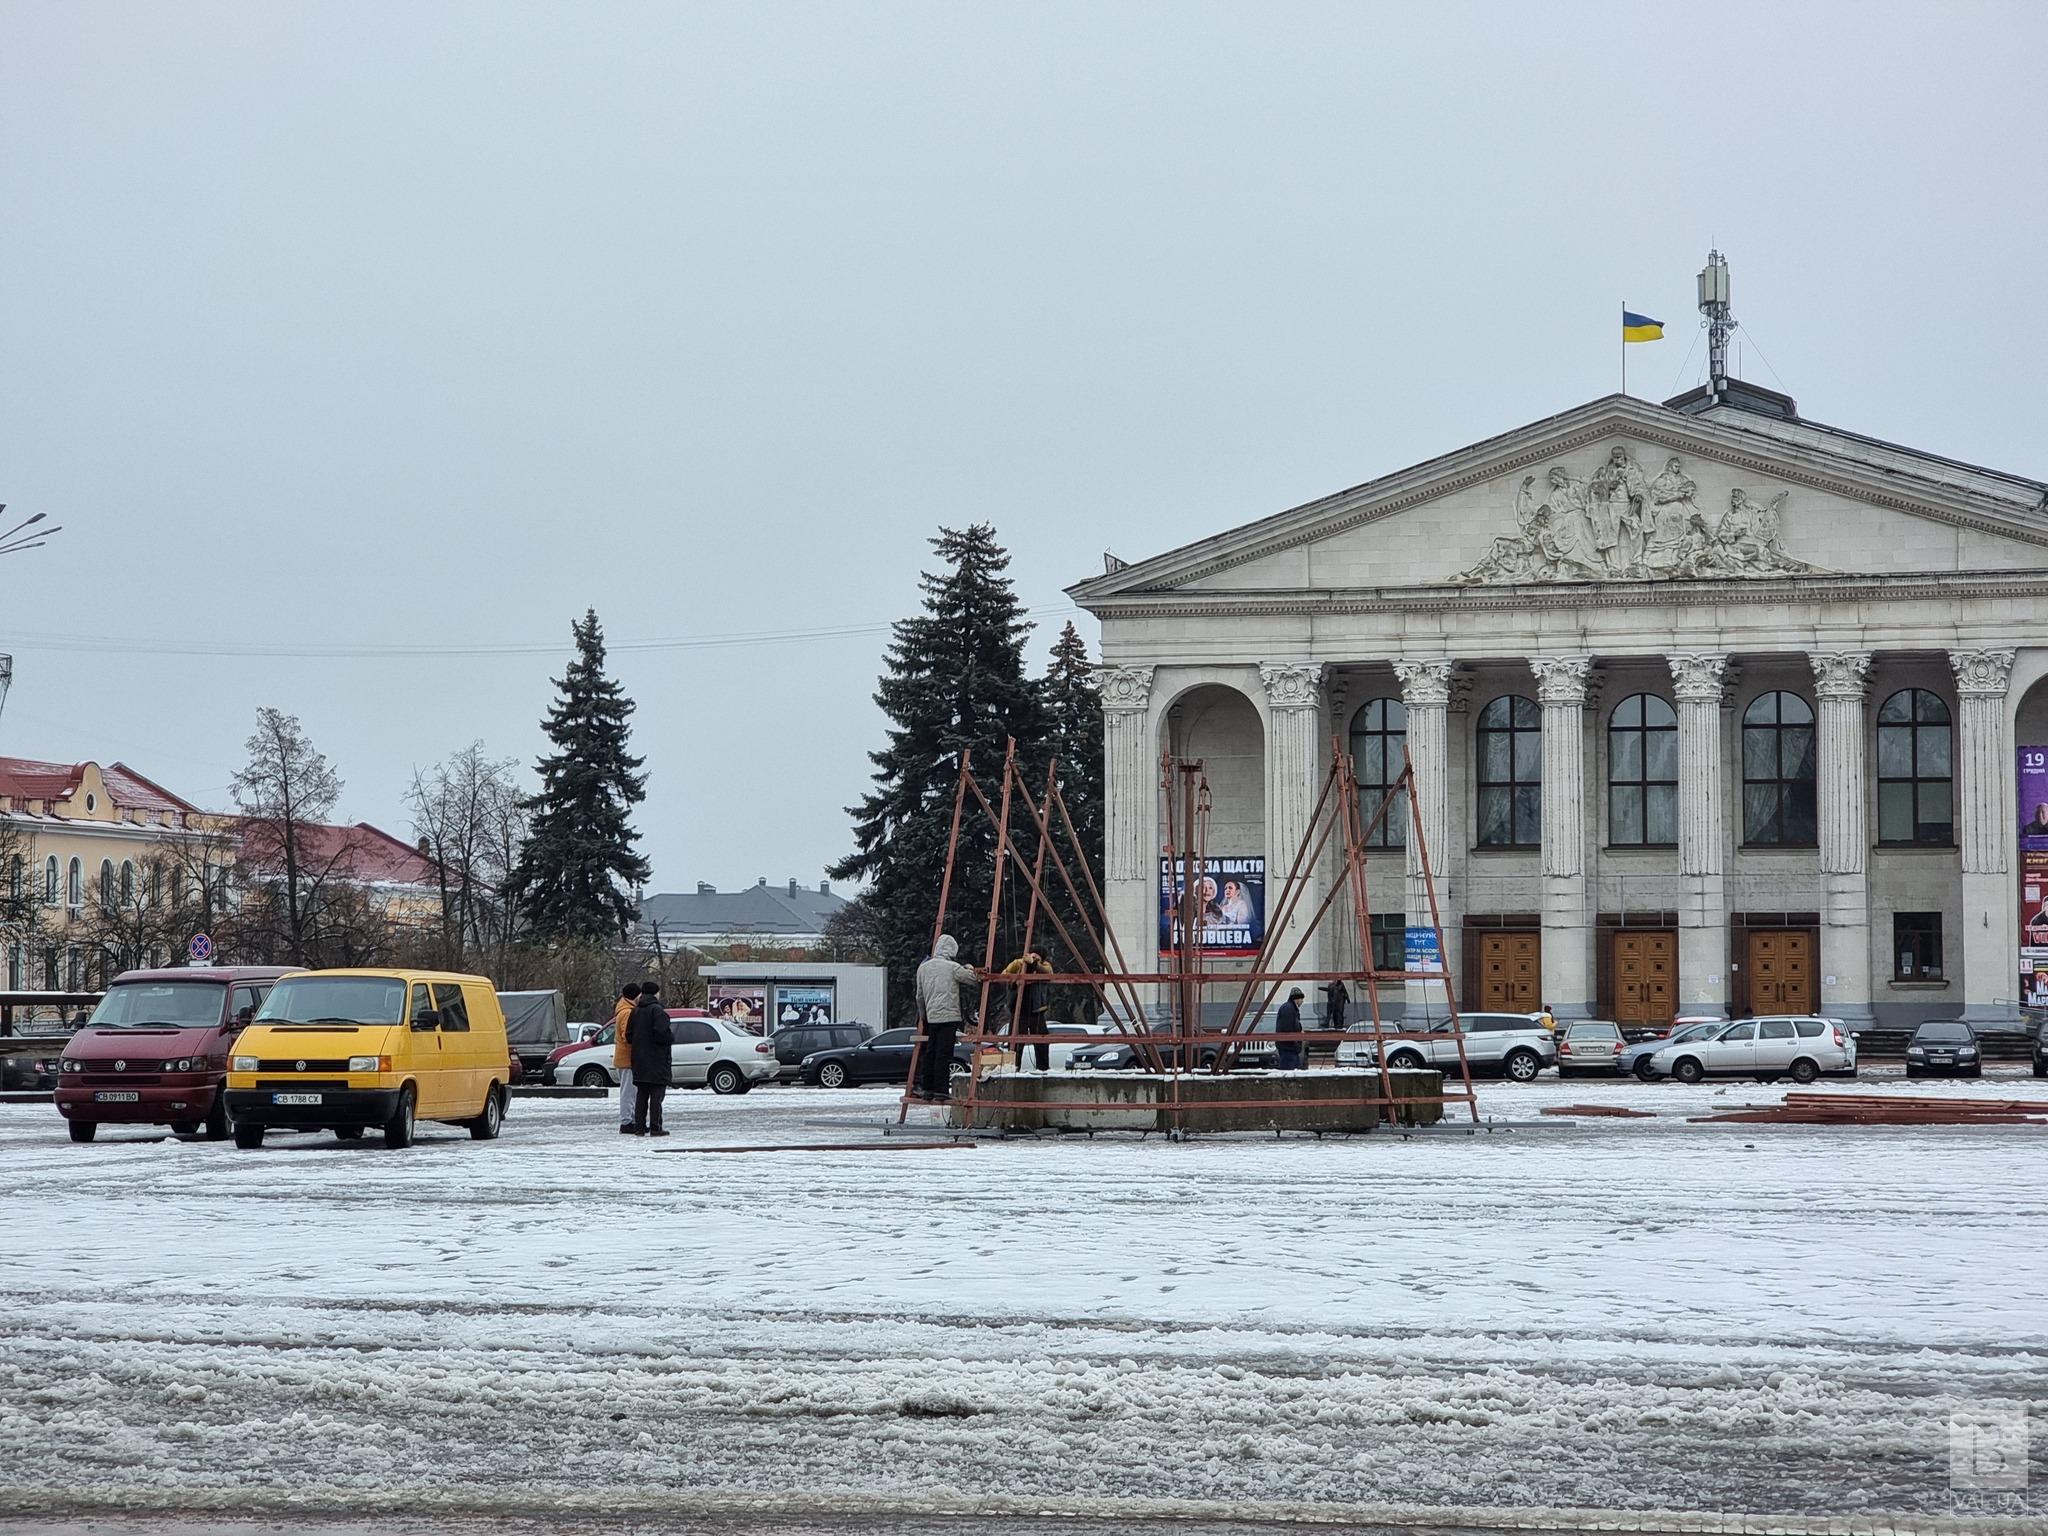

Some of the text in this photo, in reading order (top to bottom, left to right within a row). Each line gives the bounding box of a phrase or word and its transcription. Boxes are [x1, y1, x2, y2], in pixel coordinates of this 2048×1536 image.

[2025, 752, 2045, 767] 19
[1222, 859, 1264, 874] ЩАСТЯ
[98, 1093, 137, 1101] CB 0911 BO
[277, 1095, 319, 1103] CB 1788 CX
